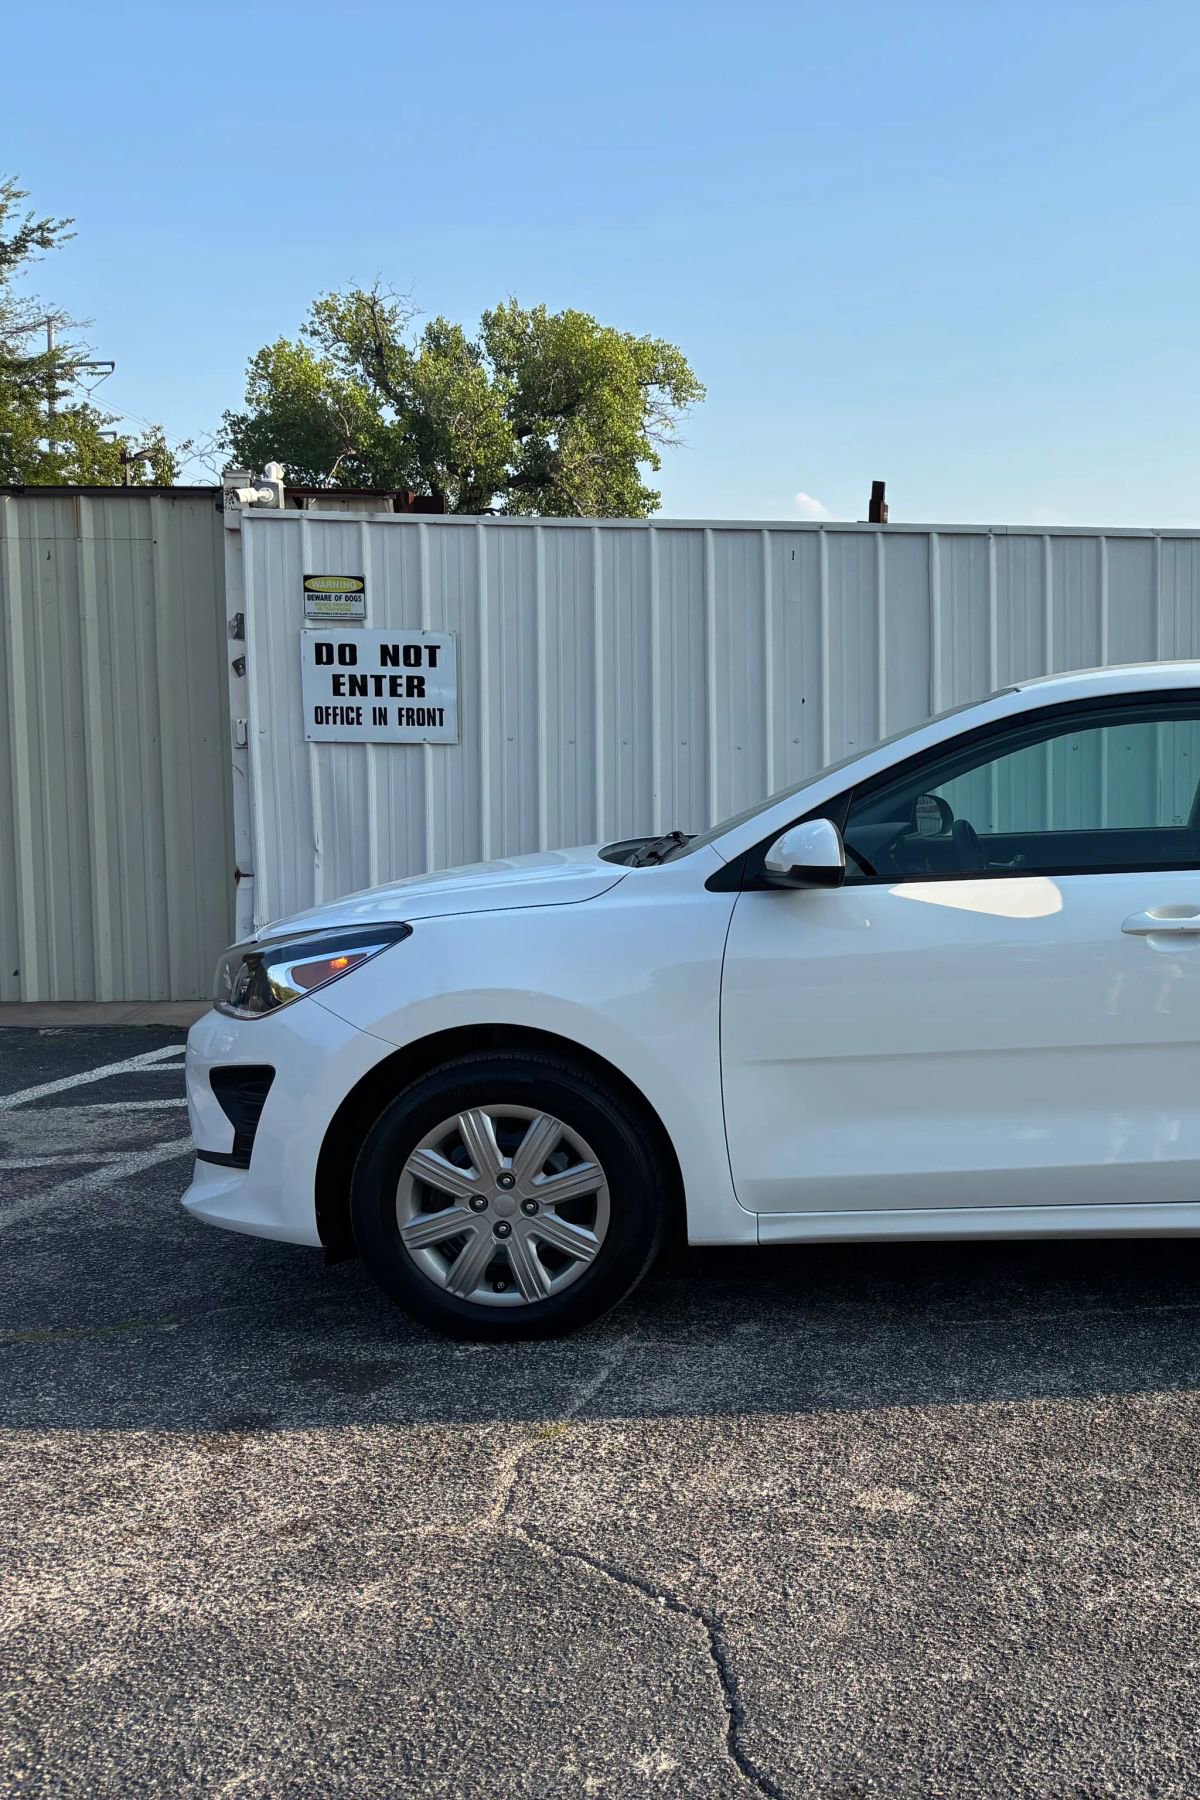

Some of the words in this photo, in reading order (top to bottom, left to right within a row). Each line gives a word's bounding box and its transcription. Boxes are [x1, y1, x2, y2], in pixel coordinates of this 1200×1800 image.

[312, 580, 357, 589] WARNING
[306, 594, 332, 602] BEWARE
[314, 642, 358, 666] DO
[379, 644, 441, 668] NOT
[331, 673, 426, 698] ENTER
[314, 705, 363, 726] OFFICE
[372, 706, 388, 726] IN
[397, 707, 445, 727] FRONT
